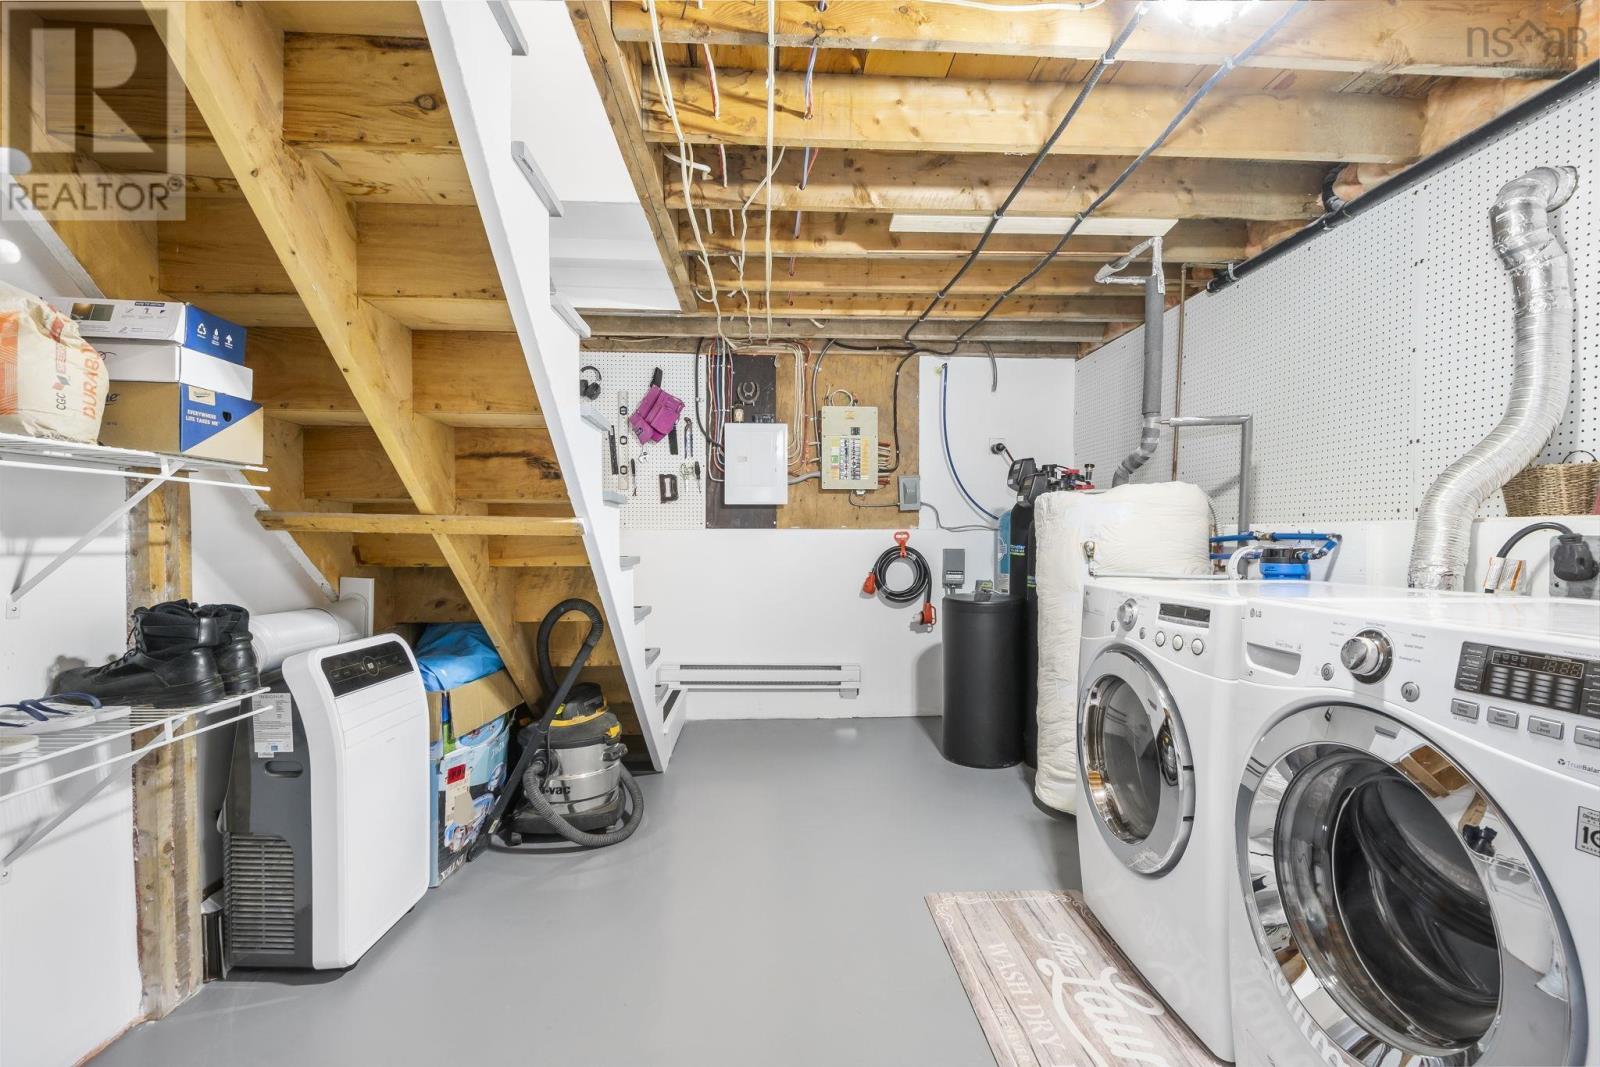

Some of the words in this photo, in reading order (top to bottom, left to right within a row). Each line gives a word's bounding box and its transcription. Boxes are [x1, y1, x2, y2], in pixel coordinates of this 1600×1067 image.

[56, 393, 66, 411] CGC
[187, 409, 217, 420] EVERYWHERE
[1036, 932, 1087, 969] The
[987, 942, 1033, 996] WASH
[1018, 1003, 1066, 1051] DRY
